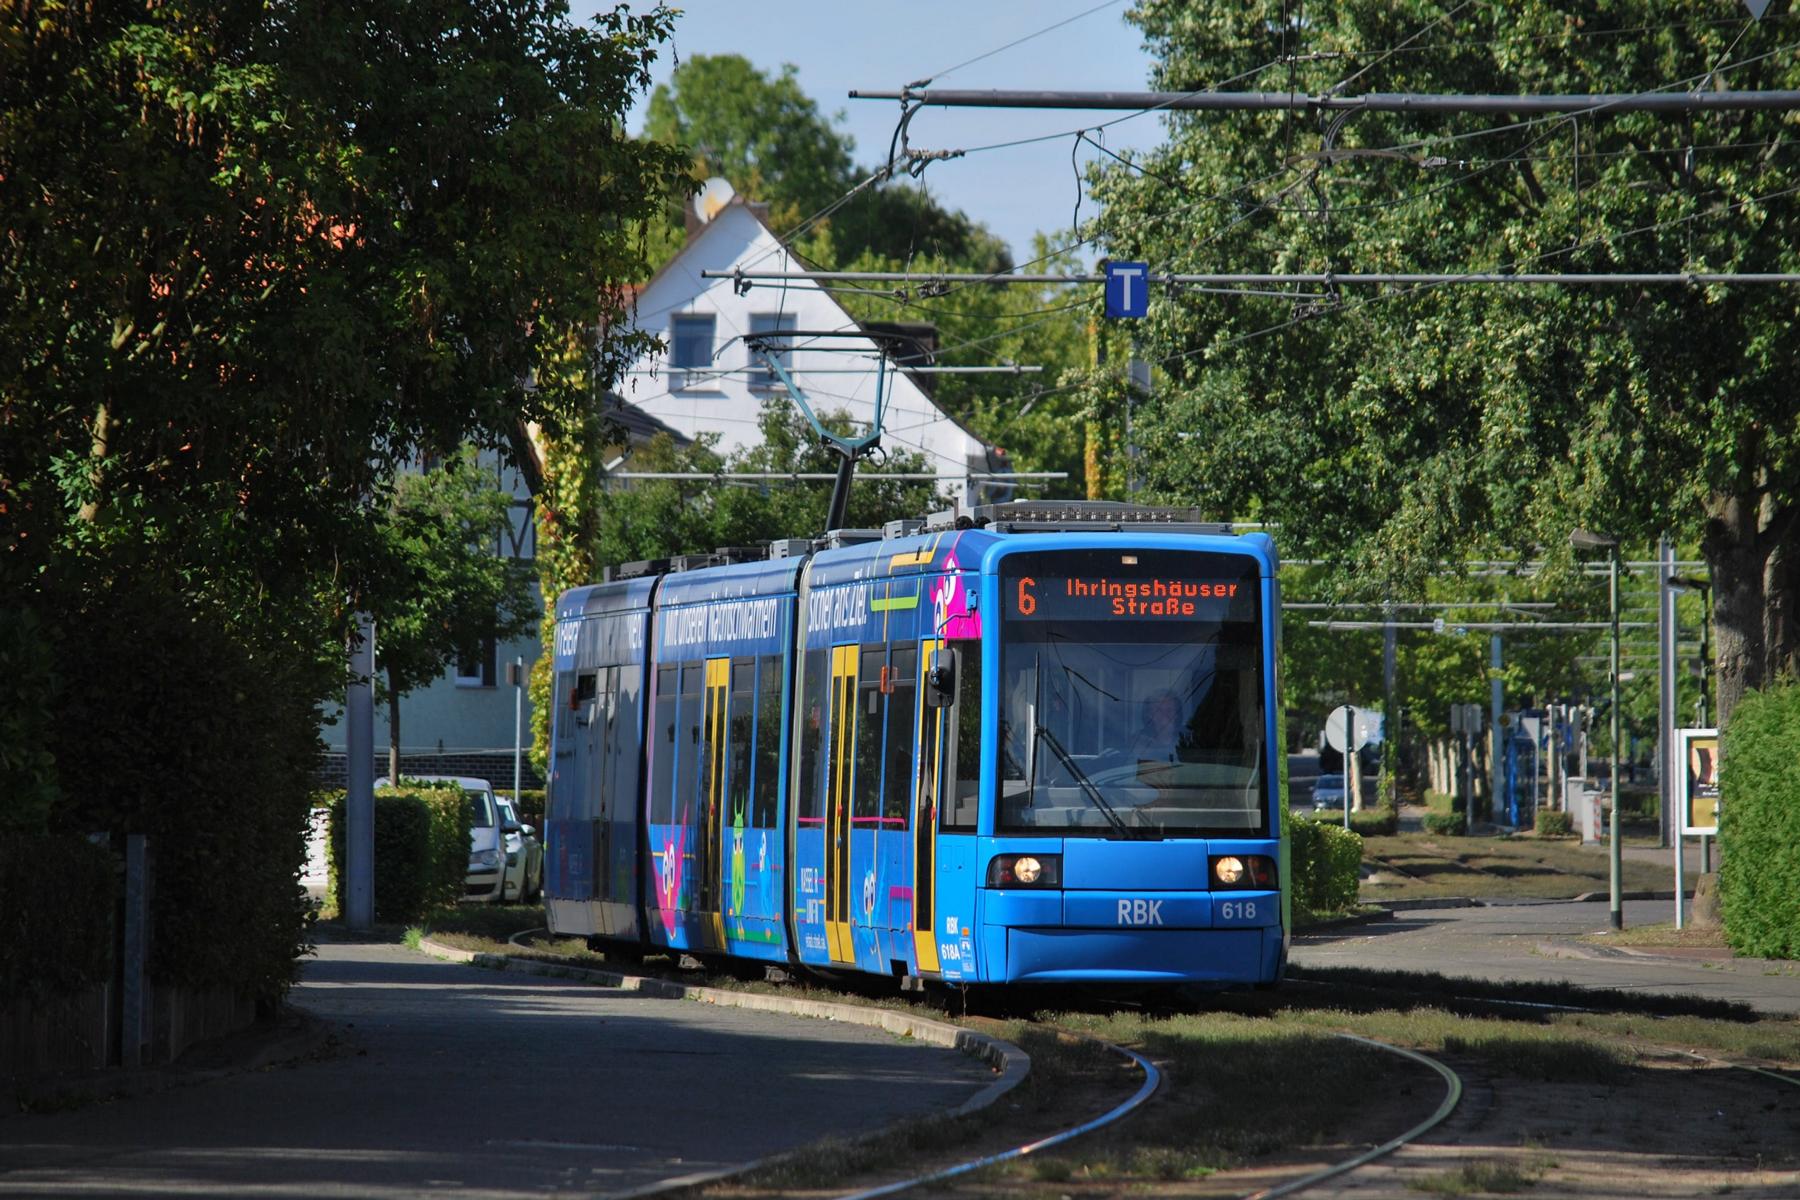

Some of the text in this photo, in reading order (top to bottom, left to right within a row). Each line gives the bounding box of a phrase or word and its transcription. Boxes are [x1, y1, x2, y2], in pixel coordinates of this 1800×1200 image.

[1112, 268, 1142, 311] T
[1017, 576, 1036, 616] 6
[1066, 578, 1237, 598] Ihringshäuser
[1112, 597, 1195, 616] Straße
[1117, 899, 1163, 925] RBK
[1221, 902, 1256, 920] 618
[941, 943, 961, 960] 618A
